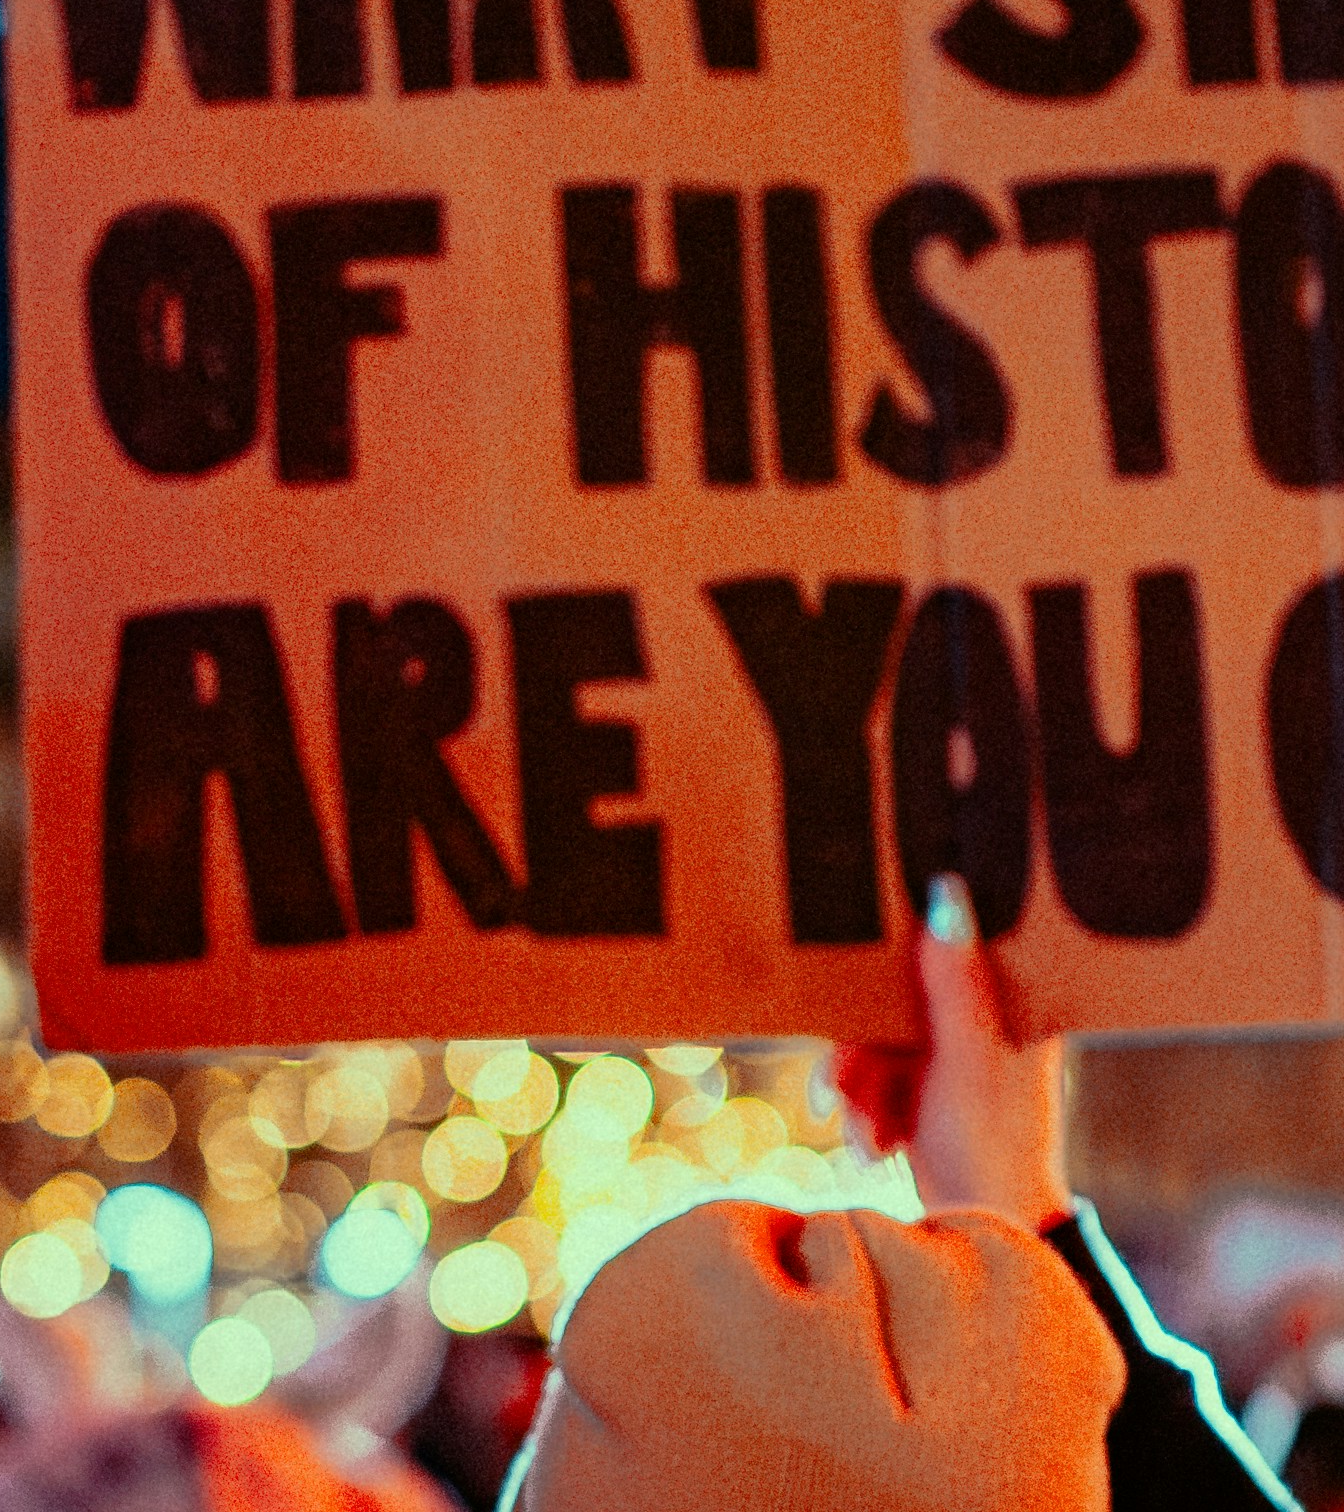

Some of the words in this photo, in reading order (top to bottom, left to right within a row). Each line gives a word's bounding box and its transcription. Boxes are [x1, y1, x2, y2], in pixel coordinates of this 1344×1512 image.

[86, 192, 446, 482] OF
[100, 586, 670, 966] ARE
[702, 566, 1216, 946] YOU
